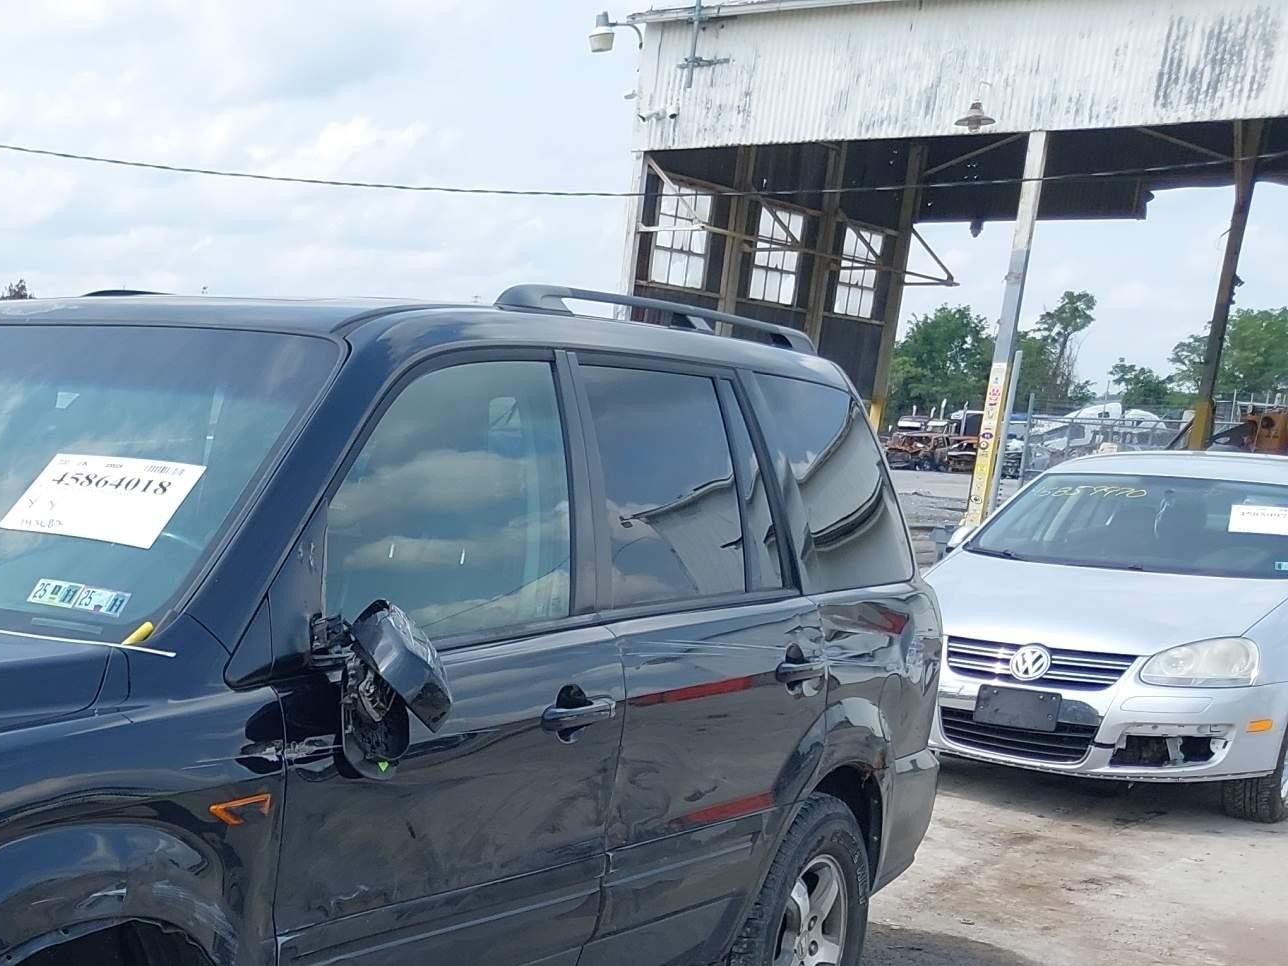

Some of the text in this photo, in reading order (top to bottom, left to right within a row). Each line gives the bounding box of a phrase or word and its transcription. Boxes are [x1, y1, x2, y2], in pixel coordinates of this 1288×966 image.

[52, 472, 171, 495] 45864018
[33, 583, 50, 599] 25
[79, 590, 95, 606] 25
